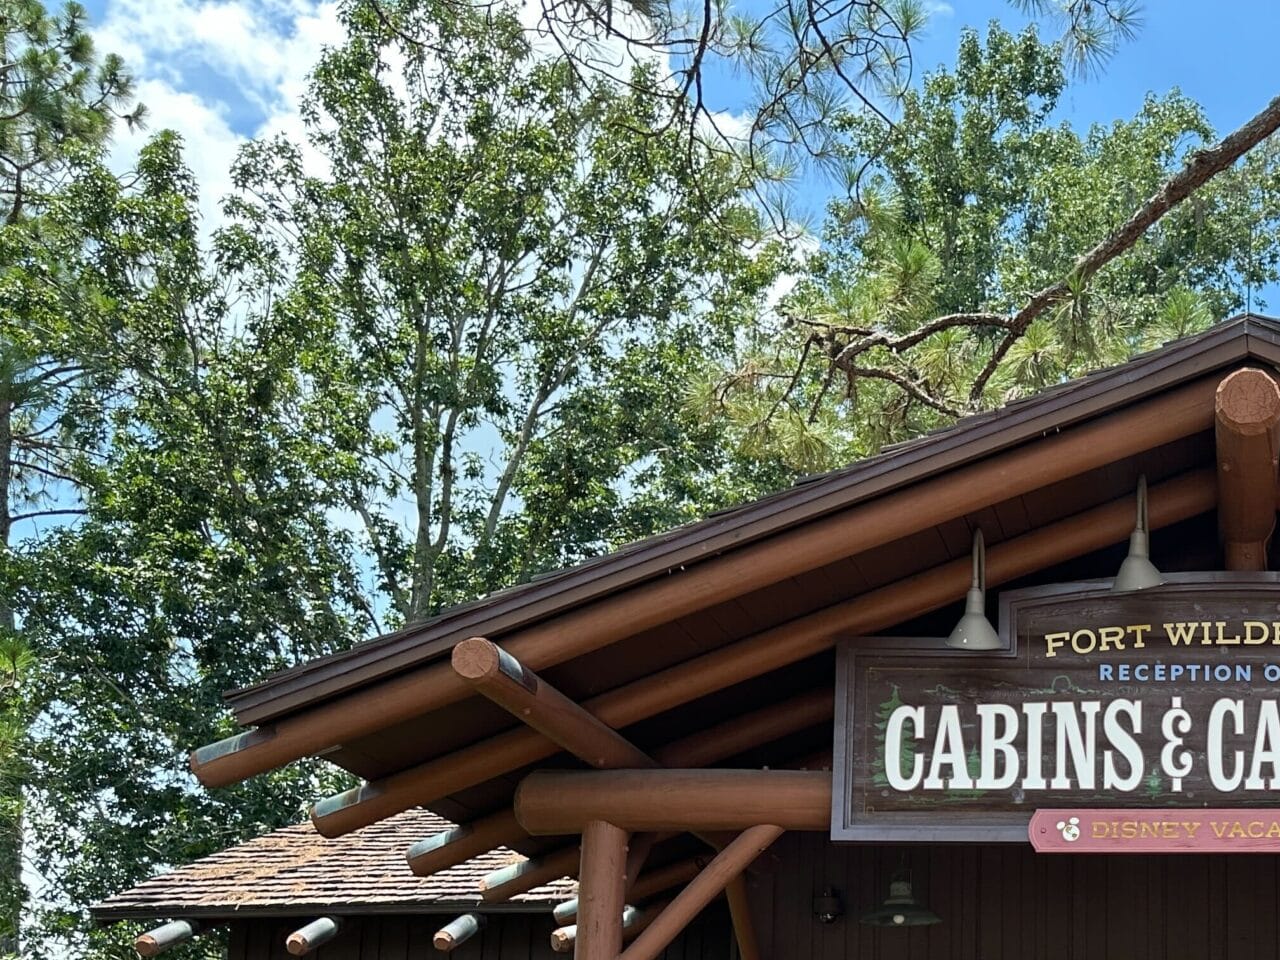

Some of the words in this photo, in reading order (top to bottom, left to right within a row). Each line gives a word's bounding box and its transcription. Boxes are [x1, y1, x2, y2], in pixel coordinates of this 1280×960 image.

[1045, 624, 1151, 658] FORT
[1099, 664, 1252, 682] RECEPTION
[884, 699, 1144, 792] CABINS
[1161, 696, 1193, 792] &
[1091, 821, 1201, 839] DISNEY
